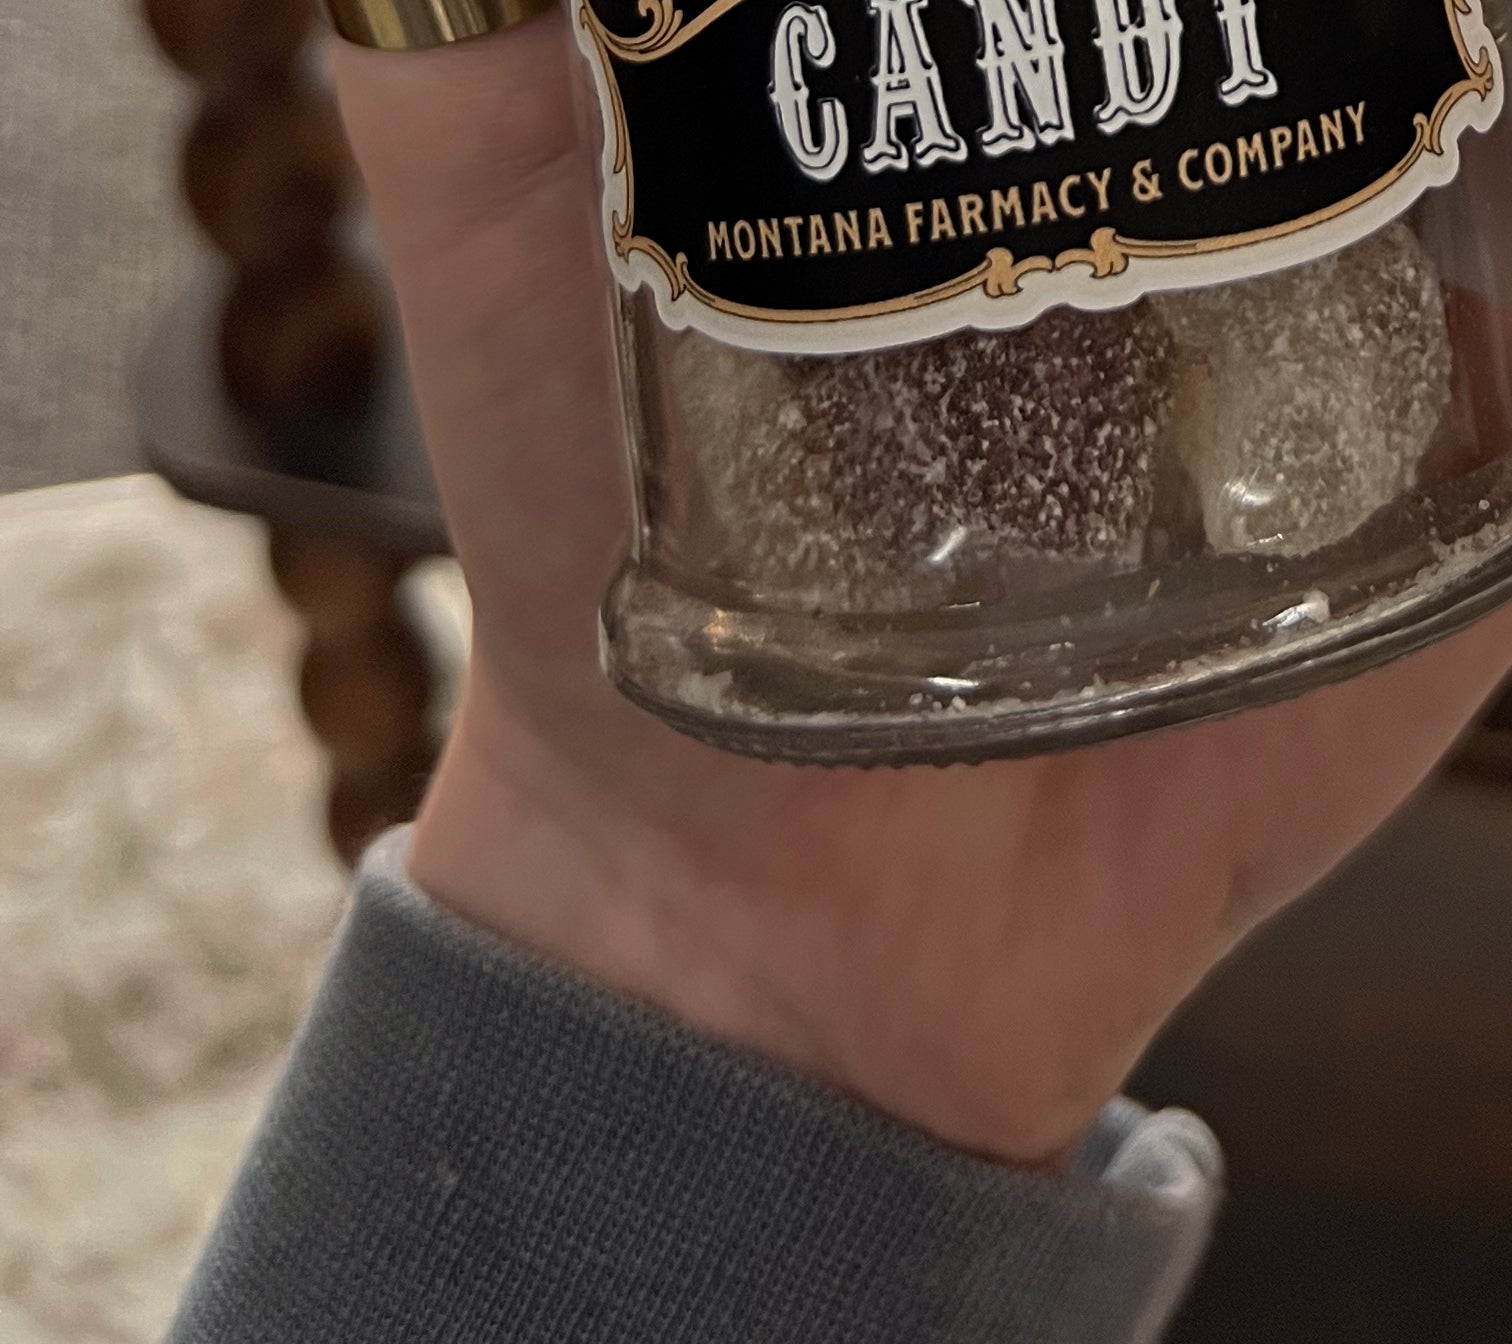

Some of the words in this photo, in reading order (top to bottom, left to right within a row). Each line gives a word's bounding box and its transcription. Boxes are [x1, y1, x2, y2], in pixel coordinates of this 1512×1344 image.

[708, 207, 892, 261] MONTANA
[906, 169, 1111, 242] FARMACY
[1132, 163, 1162, 201] &
[1178, 102, 1366, 190] COMPANY
